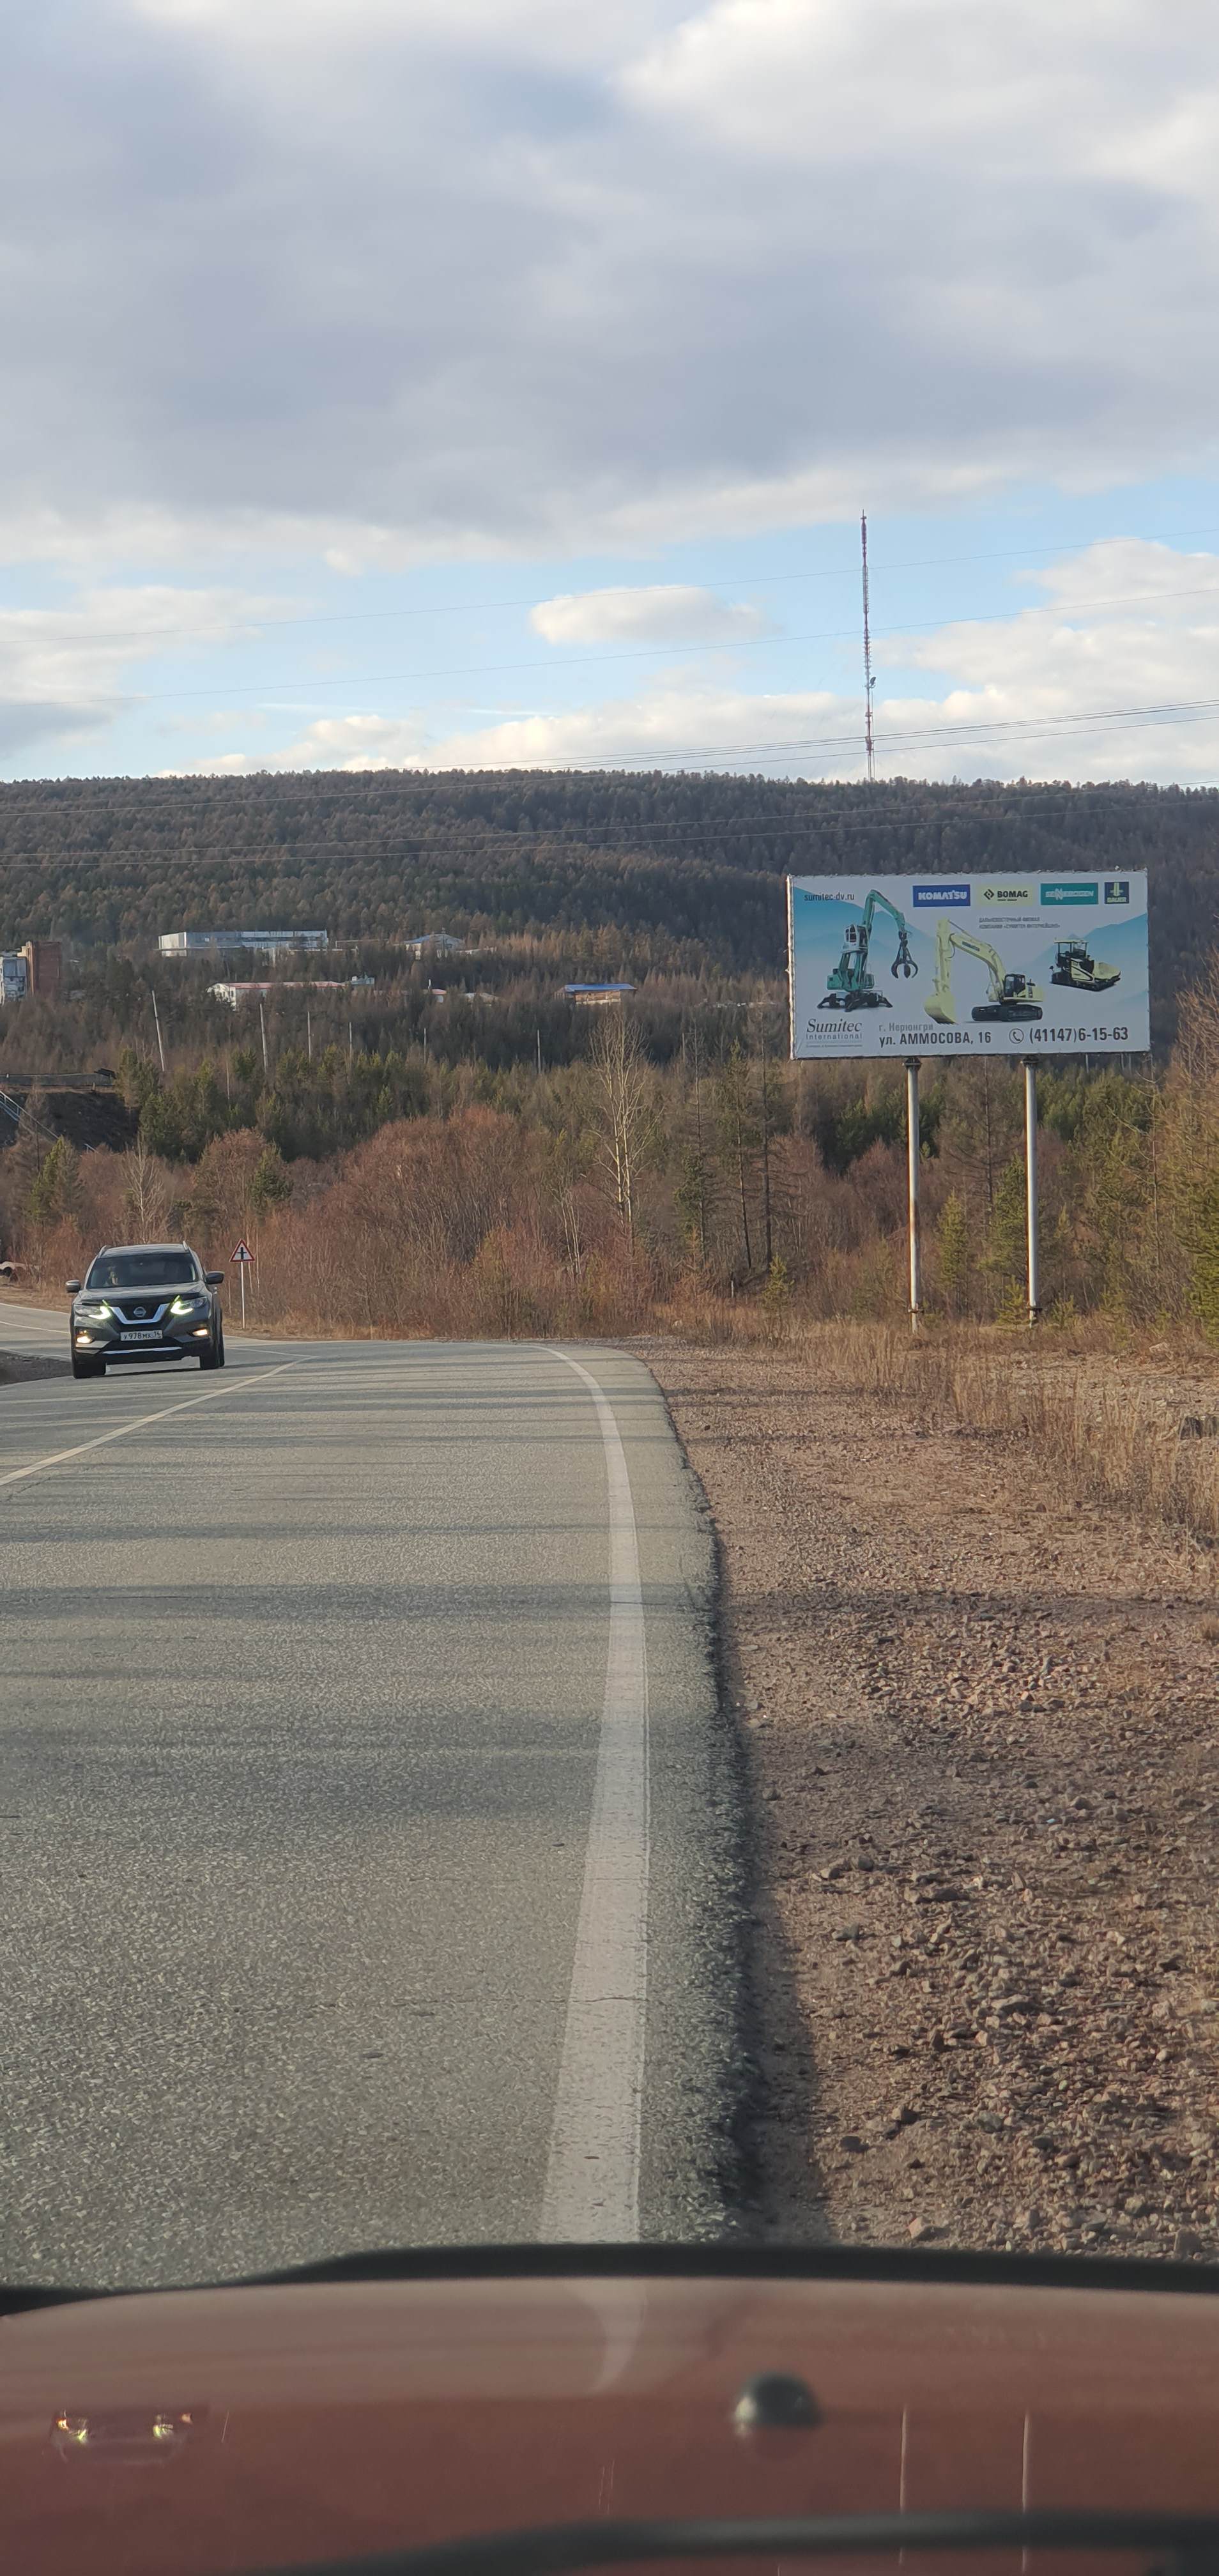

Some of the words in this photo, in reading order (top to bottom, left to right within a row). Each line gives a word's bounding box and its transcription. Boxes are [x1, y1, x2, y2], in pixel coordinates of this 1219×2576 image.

[804, 891, 855, 901] sumitec-dv.ru
[917, 890, 967, 900] KOMATSU
[997, 890, 1028, 898] BOMAG
[806, 1018, 862, 1032] Sumitec
[889, 1023, 933, 1032] Нерюнгри
[878, 1036, 896, 1048] ул.
[900, 1032, 974, 1045] АММОСОВА,
[978, 1031, 992, 1043] 16
